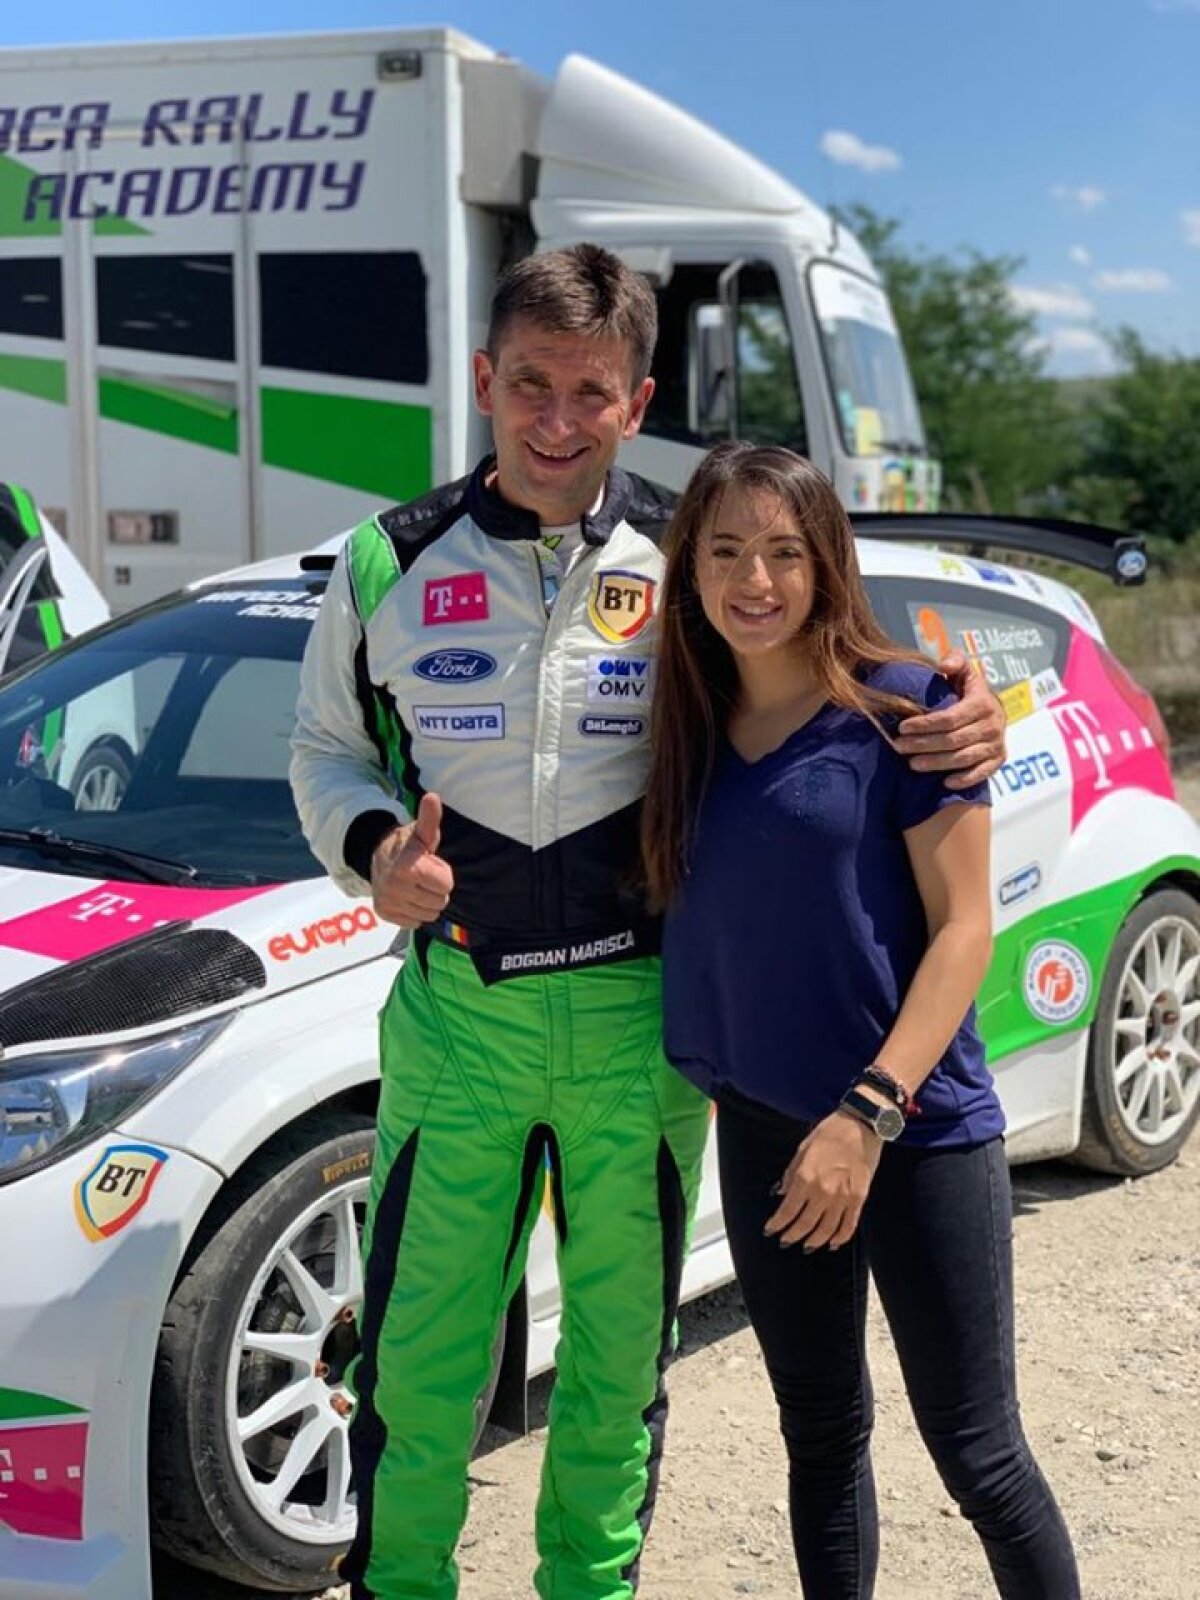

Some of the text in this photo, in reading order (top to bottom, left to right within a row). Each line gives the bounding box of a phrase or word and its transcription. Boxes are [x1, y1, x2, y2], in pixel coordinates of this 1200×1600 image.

[141, 88, 376, 147] RALLY
[23, 160, 366, 222] ACADEMY
[604, 586, 642, 613] BT
[429, 653, 480, 677] Ford
[598, 680, 646, 697] OMV
[419, 716, 449, 729] NTT
[501, 929, 635, 971] BOGDAN MARISCA
[95, 1164, 147, 1197] BT
